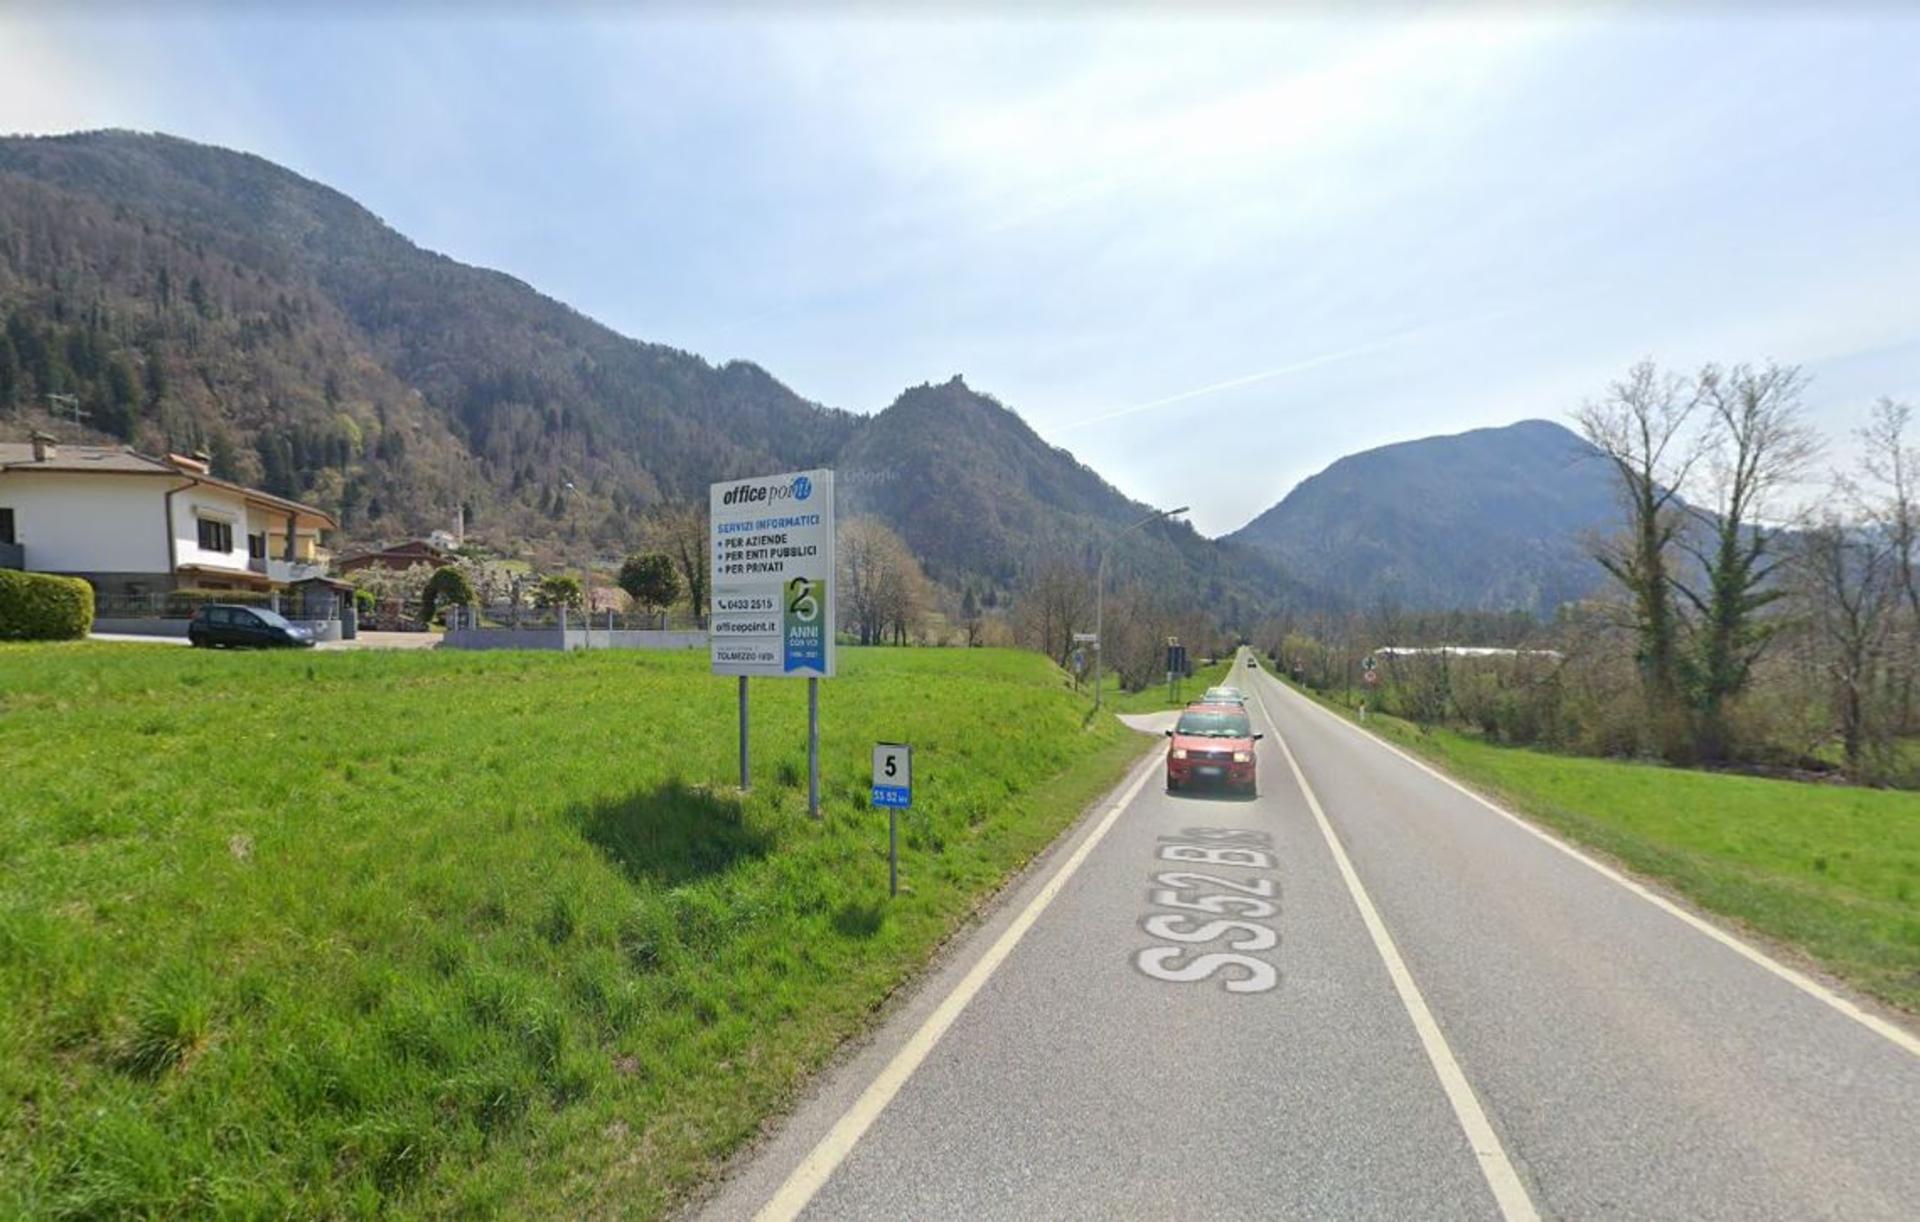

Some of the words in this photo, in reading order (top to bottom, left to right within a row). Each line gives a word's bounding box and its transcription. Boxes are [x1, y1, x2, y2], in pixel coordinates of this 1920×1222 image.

[718, 522, 754, 534] SERVIZI
[756, 514, 820, 530] INFORMATICI
[725, 538, 744, 549] PER
[746, 534, 788, 546] AZIENDE
[725, 551, 744, 562] PER
[746, 548, 768, 560] ENTI
[770, 545, 817, 558] PUBBLICI
[725, 564, 744, 575] PER
[746, 561, 784, 573] PRIVATI
[728, 599, 749, 610] 0433
[790, 626, 818, 638] ANNI
[885, 755, 896, 777] 5
